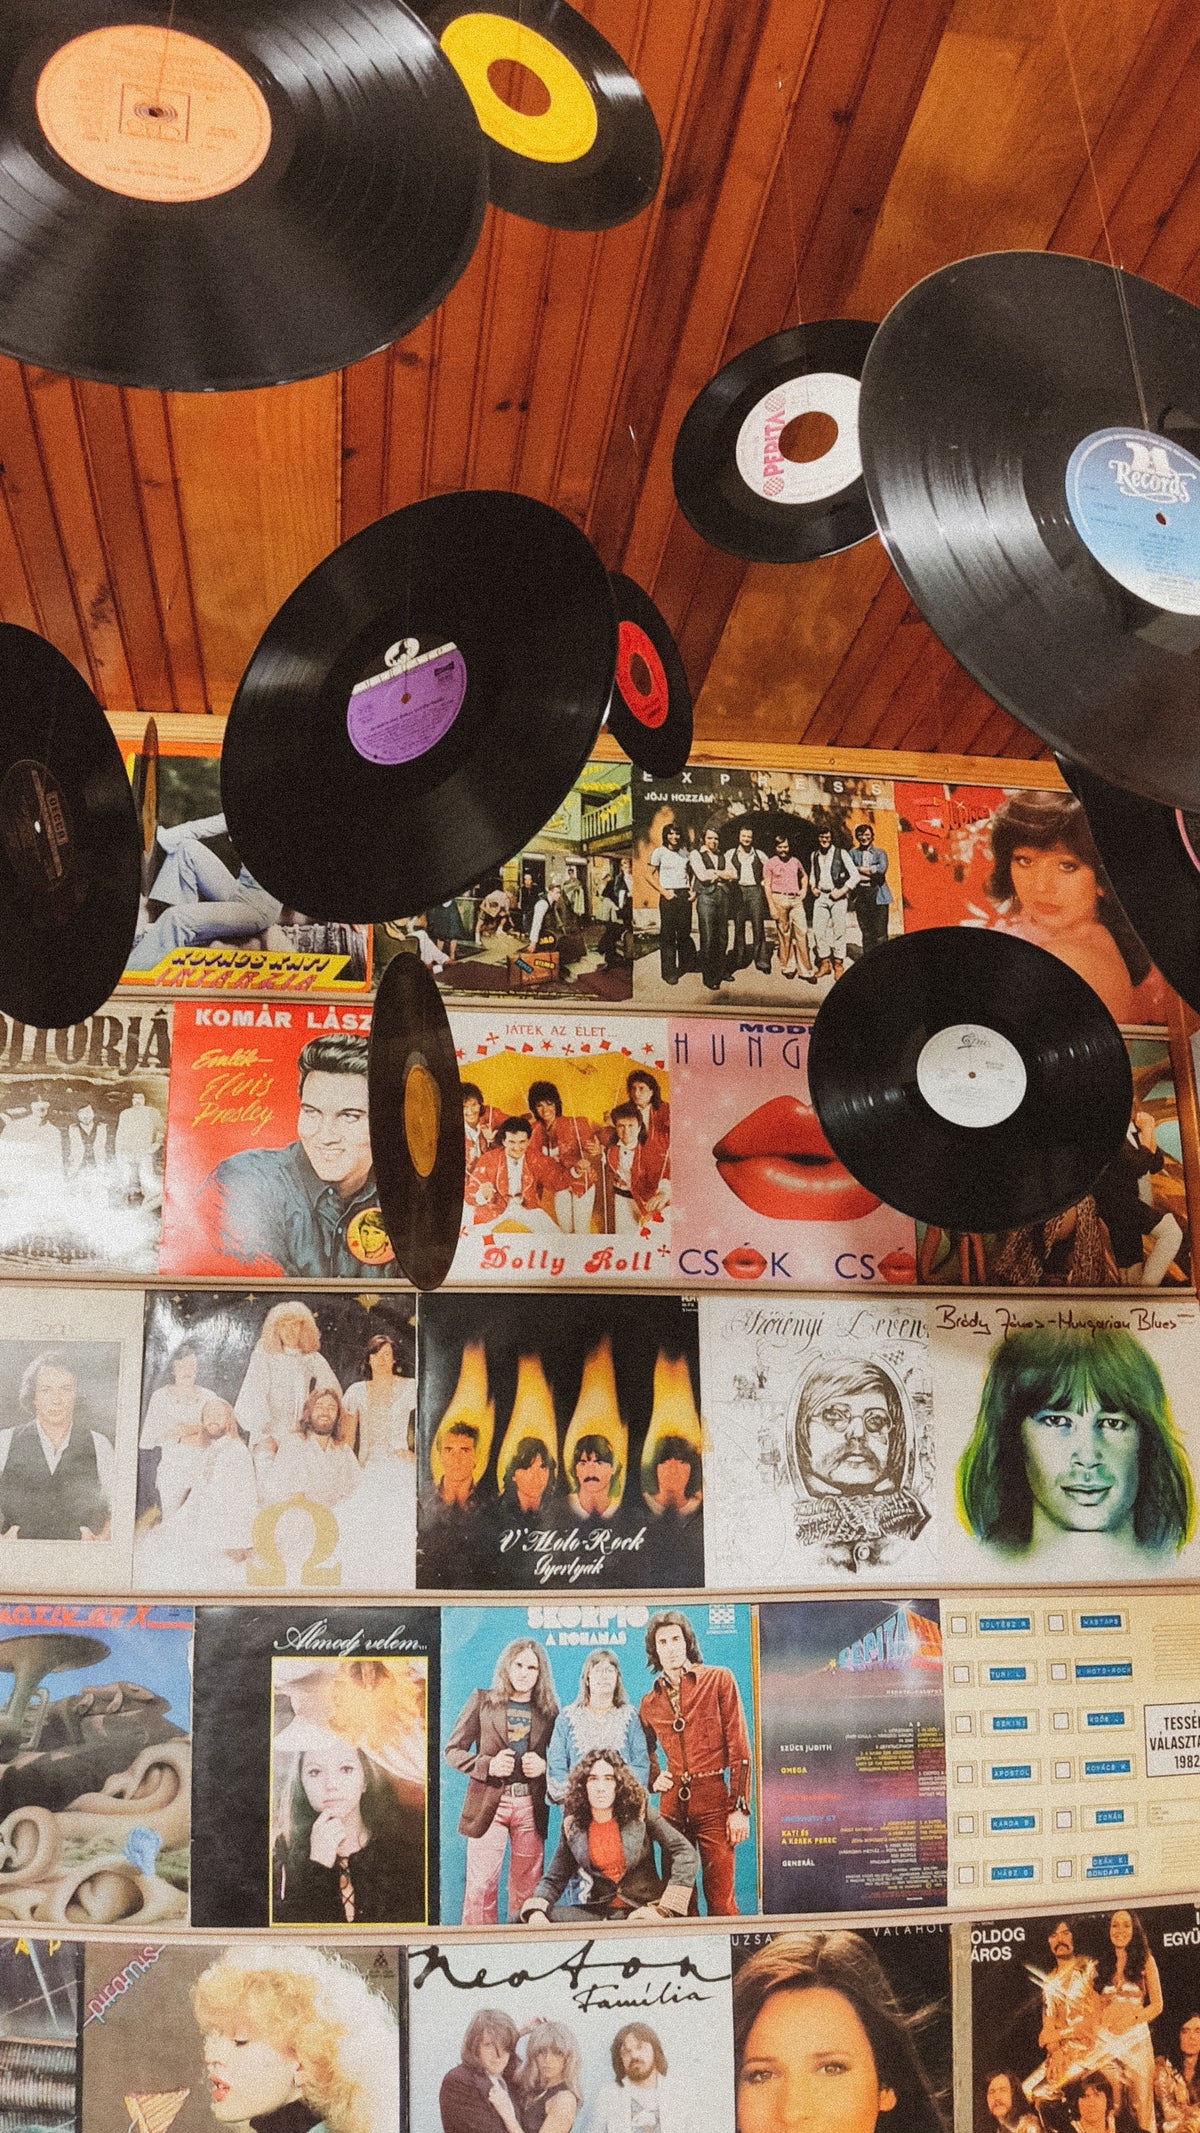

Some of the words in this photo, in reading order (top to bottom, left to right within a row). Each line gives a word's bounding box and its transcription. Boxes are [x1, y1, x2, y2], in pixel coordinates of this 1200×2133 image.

[763, 410, 785, 477] PEPITA
[1108, 459, 1197, 504] Records
[195, 1004, 292, 1029] KOMÁR
[550, 1025, 567, 1036] AZ
[198, 1072, 274, 1102] Elvis
[191, 1099, 274, 1137] Presley
[480, 1245, 565, 1277] Dolly
[583, 1246, 652, 1274] Roll
[935, 1304, 992, 1334] Bródy
[1130, 1307, 1177, 1331] Blues
[780, 1766, 808, 1774] OMEGA
[1174, 1754, 1200, 1769] 1982
[782, 1858, 816, 1867] GENERÁL
